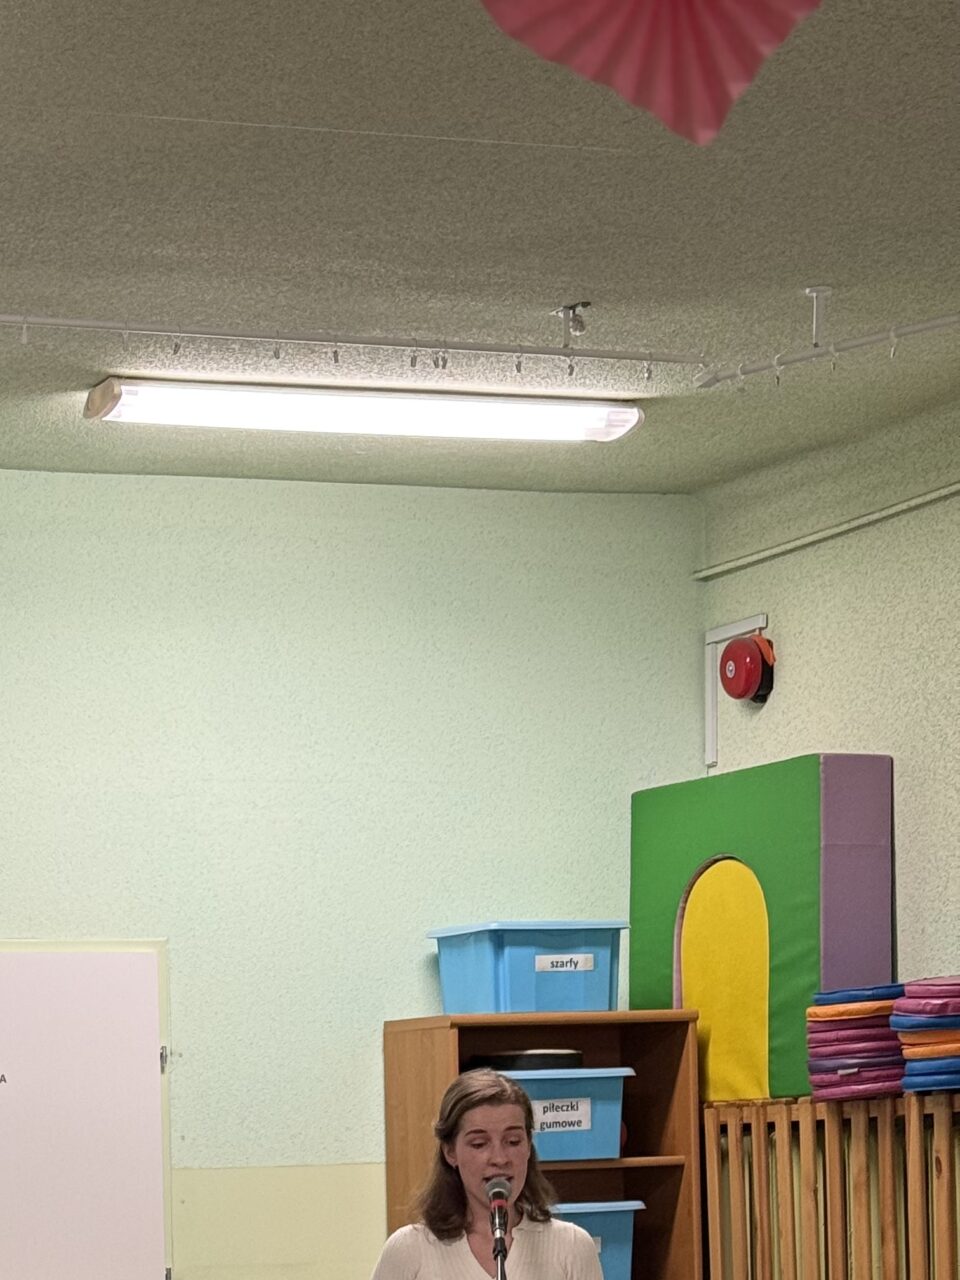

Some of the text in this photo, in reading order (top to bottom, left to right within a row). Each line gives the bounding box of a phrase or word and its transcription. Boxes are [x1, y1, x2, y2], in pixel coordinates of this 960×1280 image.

[550, 957, 579, 970] szarfy
[542, 1101, 579, 1115] piłeczki
[540, 1119, 582, 1131] gumowe
